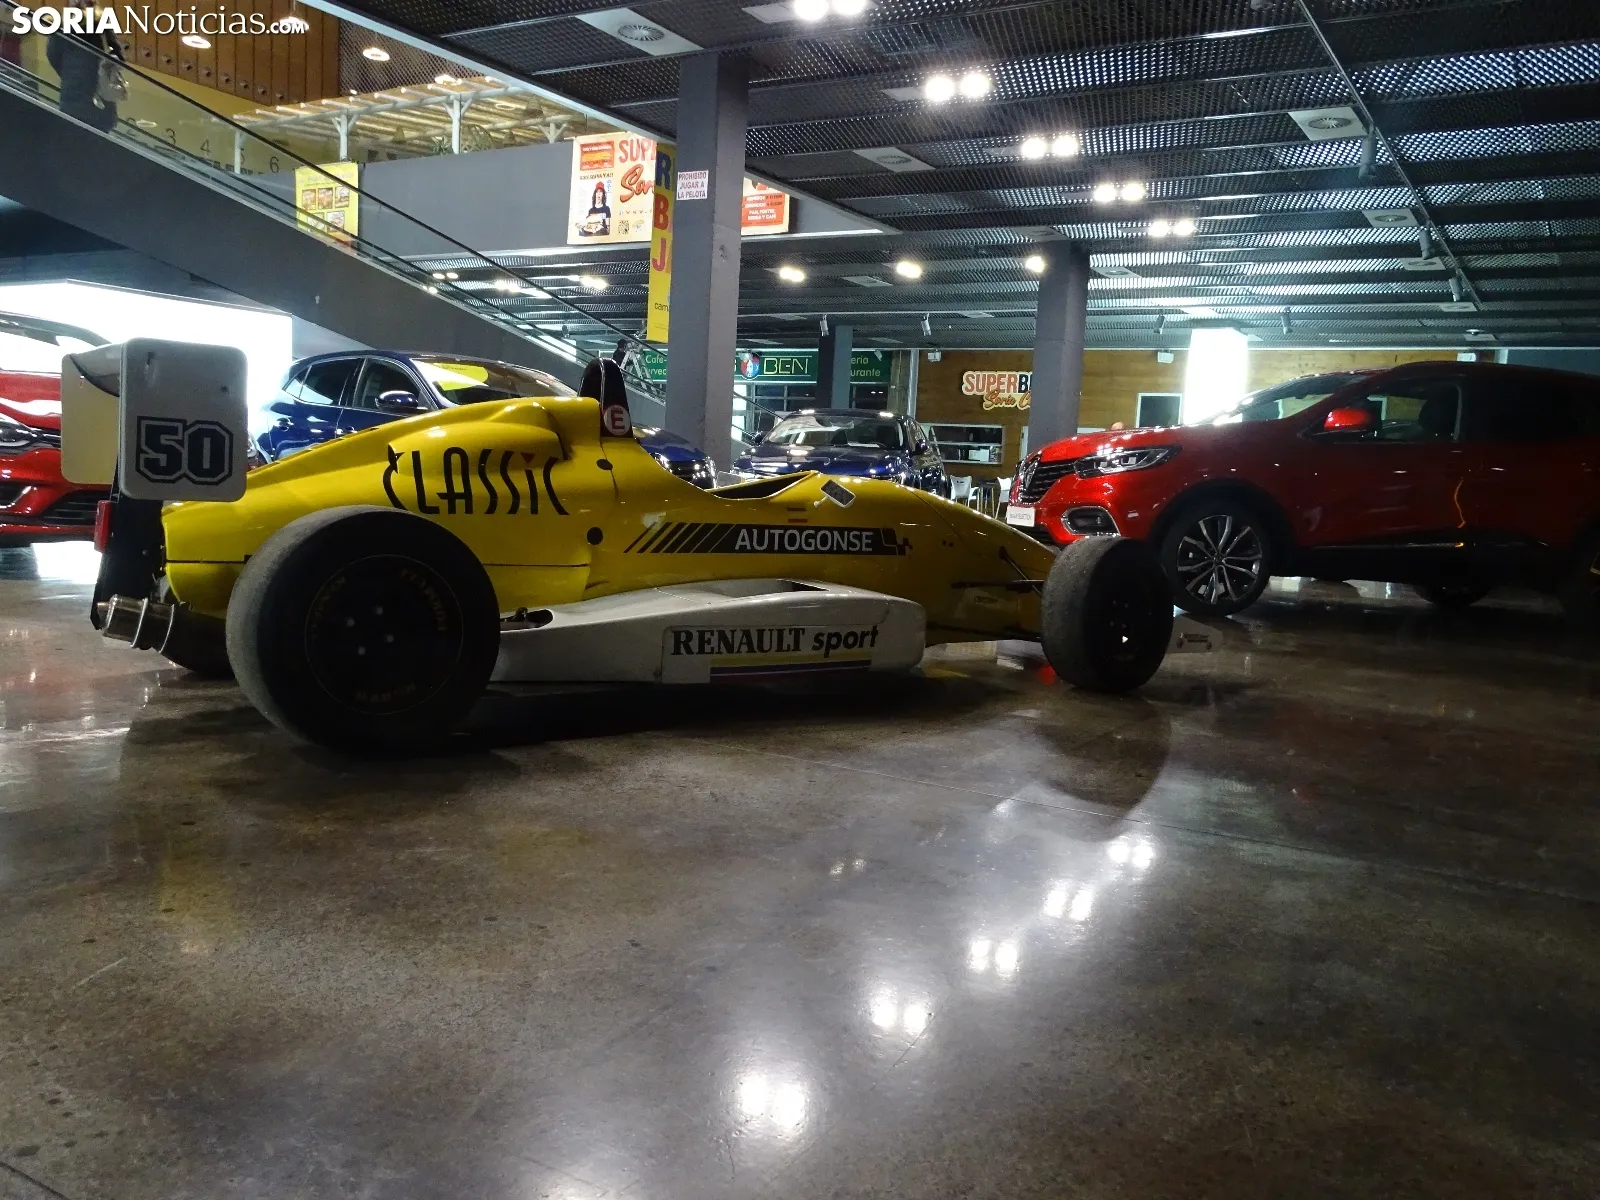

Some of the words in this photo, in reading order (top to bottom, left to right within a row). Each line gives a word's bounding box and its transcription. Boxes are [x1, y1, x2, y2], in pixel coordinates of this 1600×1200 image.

[763, 357, 809, 375] BEN
[850, 368, 881, 377] urante
[964, 373, 1033, 394] SUPERB
[610, 409, 626, 430] E
[137, 415, 233, 486] 50
[735, 528, 874, 552] AUTOGONSE
[671, 628, 806, 656] RENAULT
[811, 625, 879, 659] sport
